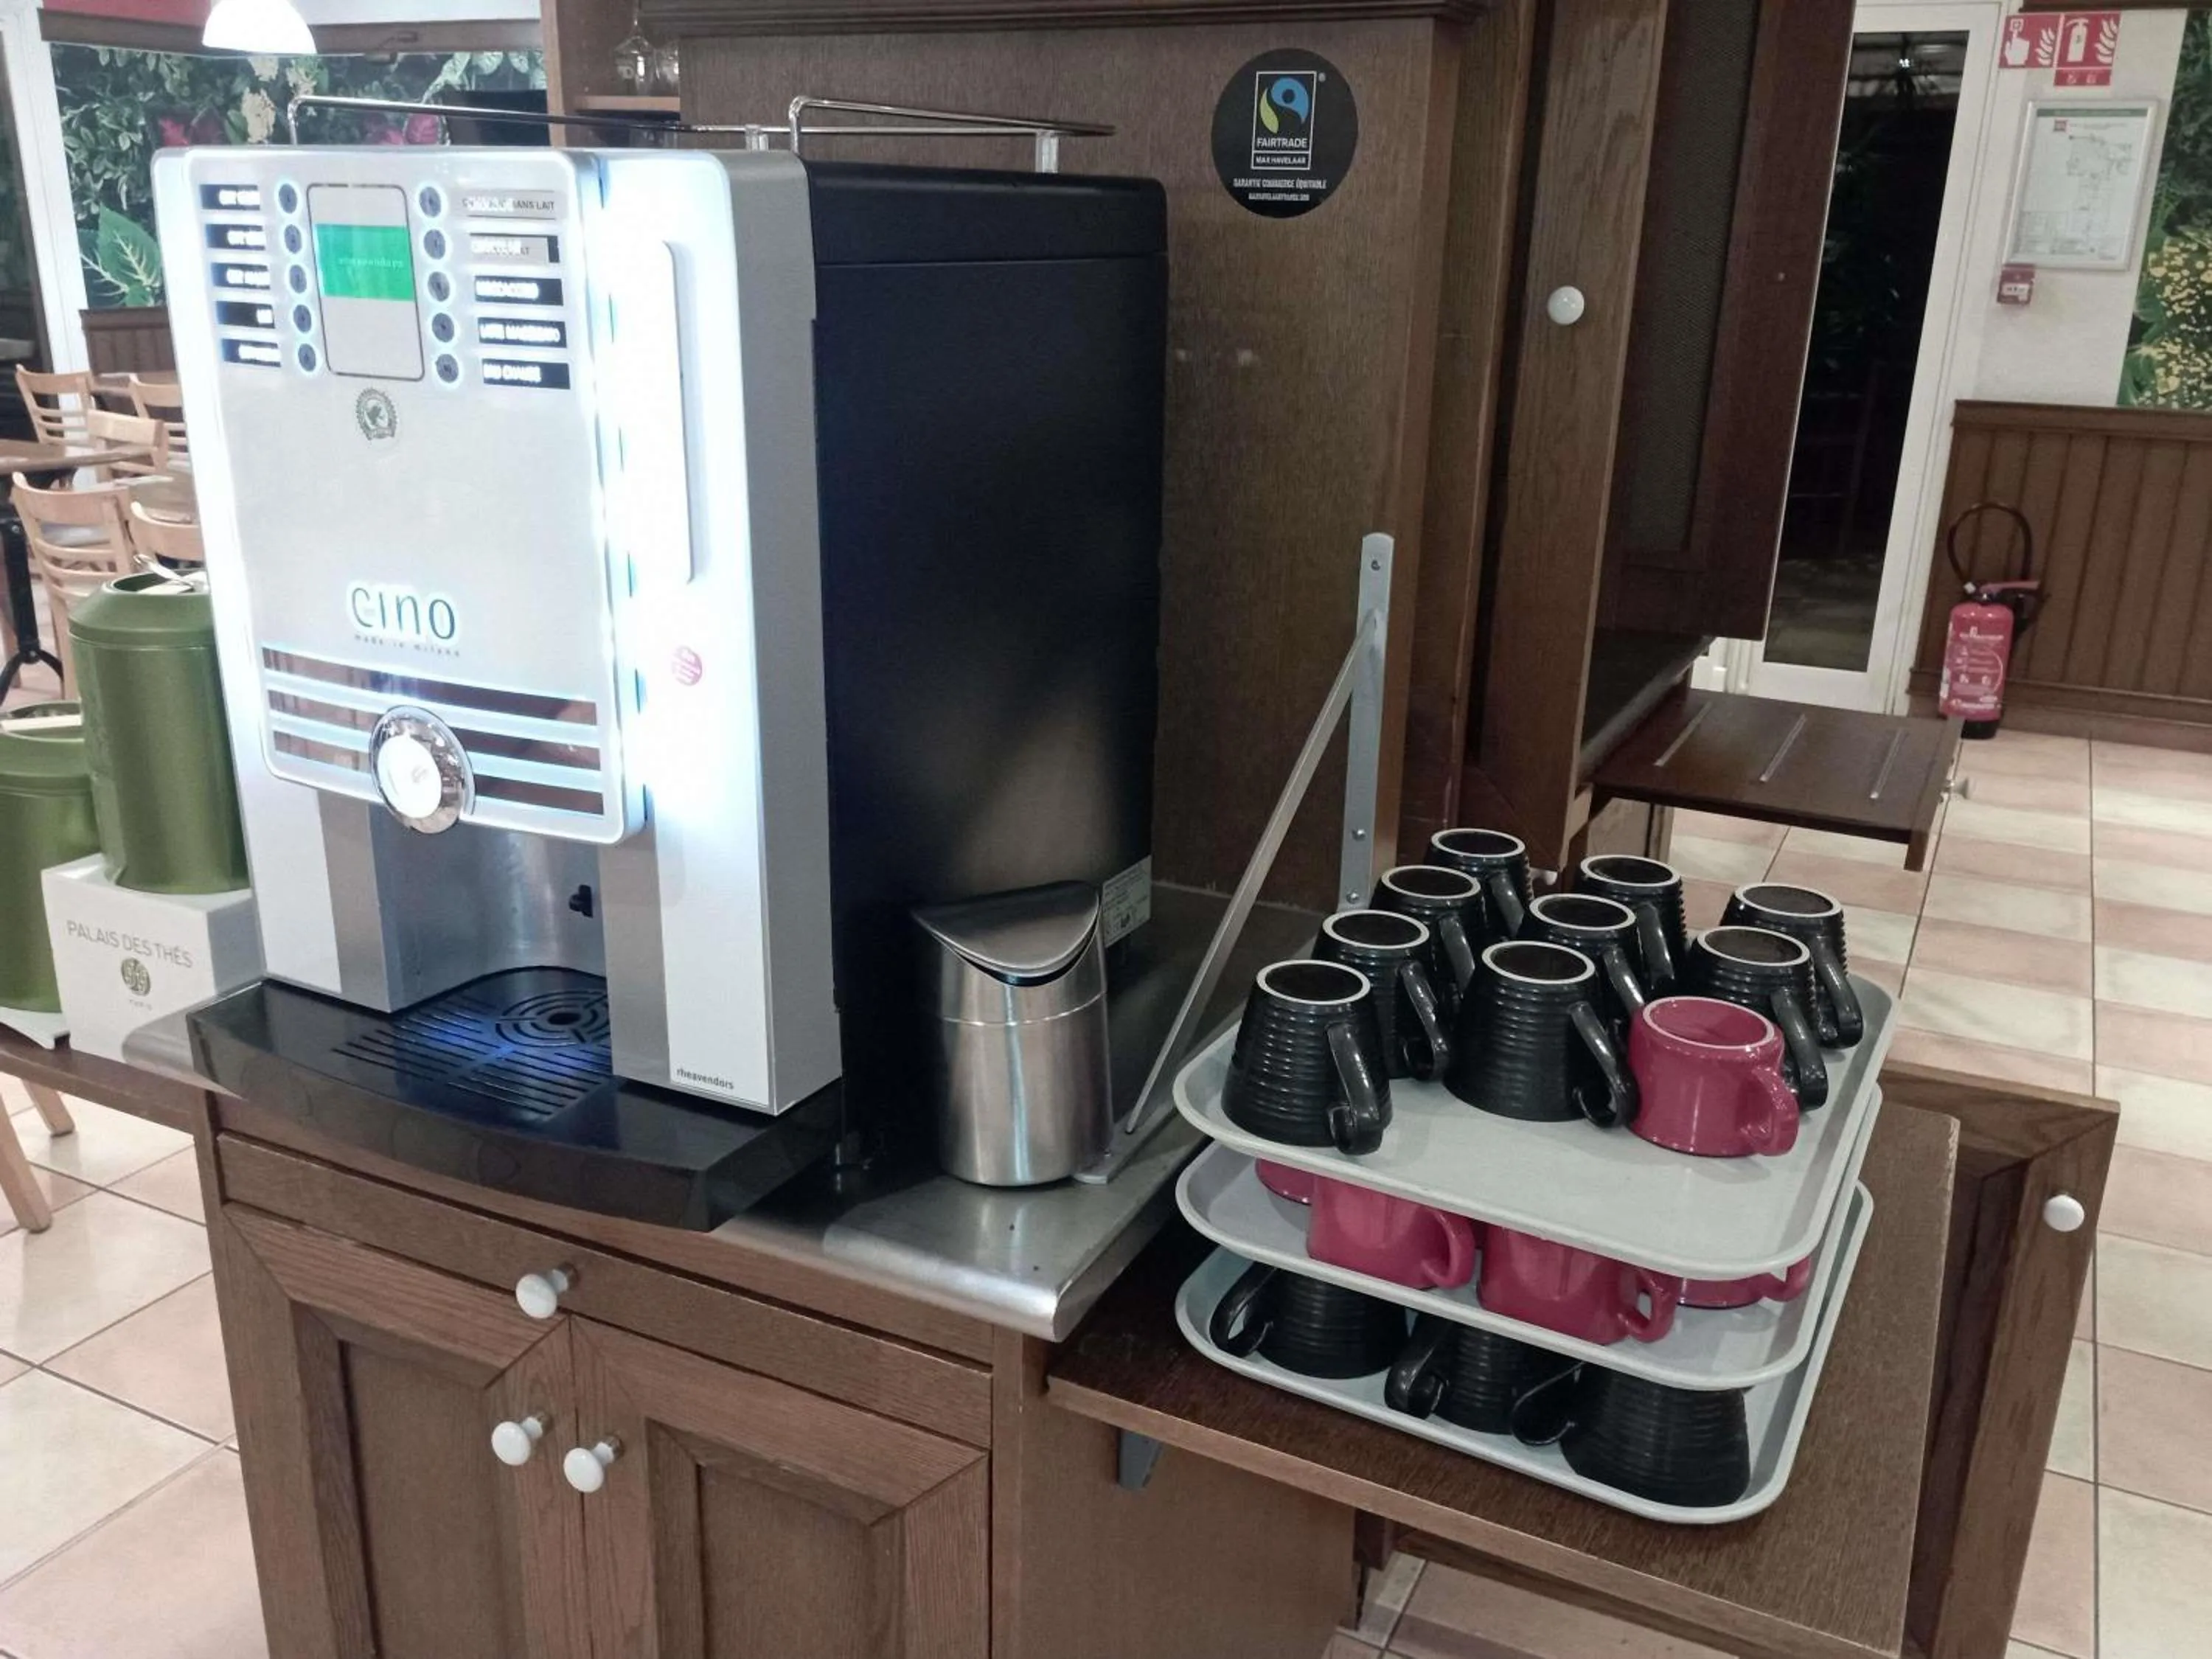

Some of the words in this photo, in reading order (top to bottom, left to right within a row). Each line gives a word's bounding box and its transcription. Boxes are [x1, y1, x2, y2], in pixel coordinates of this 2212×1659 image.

[1256, 138, 1307, 147] FAIRTRADE
[66, 920, 119, 948] PALAIS
[122, 933, 152, 956] DES
[154, 943, 193, 968] THÉS
[676, 1068, 734, 1090] rheavendors
